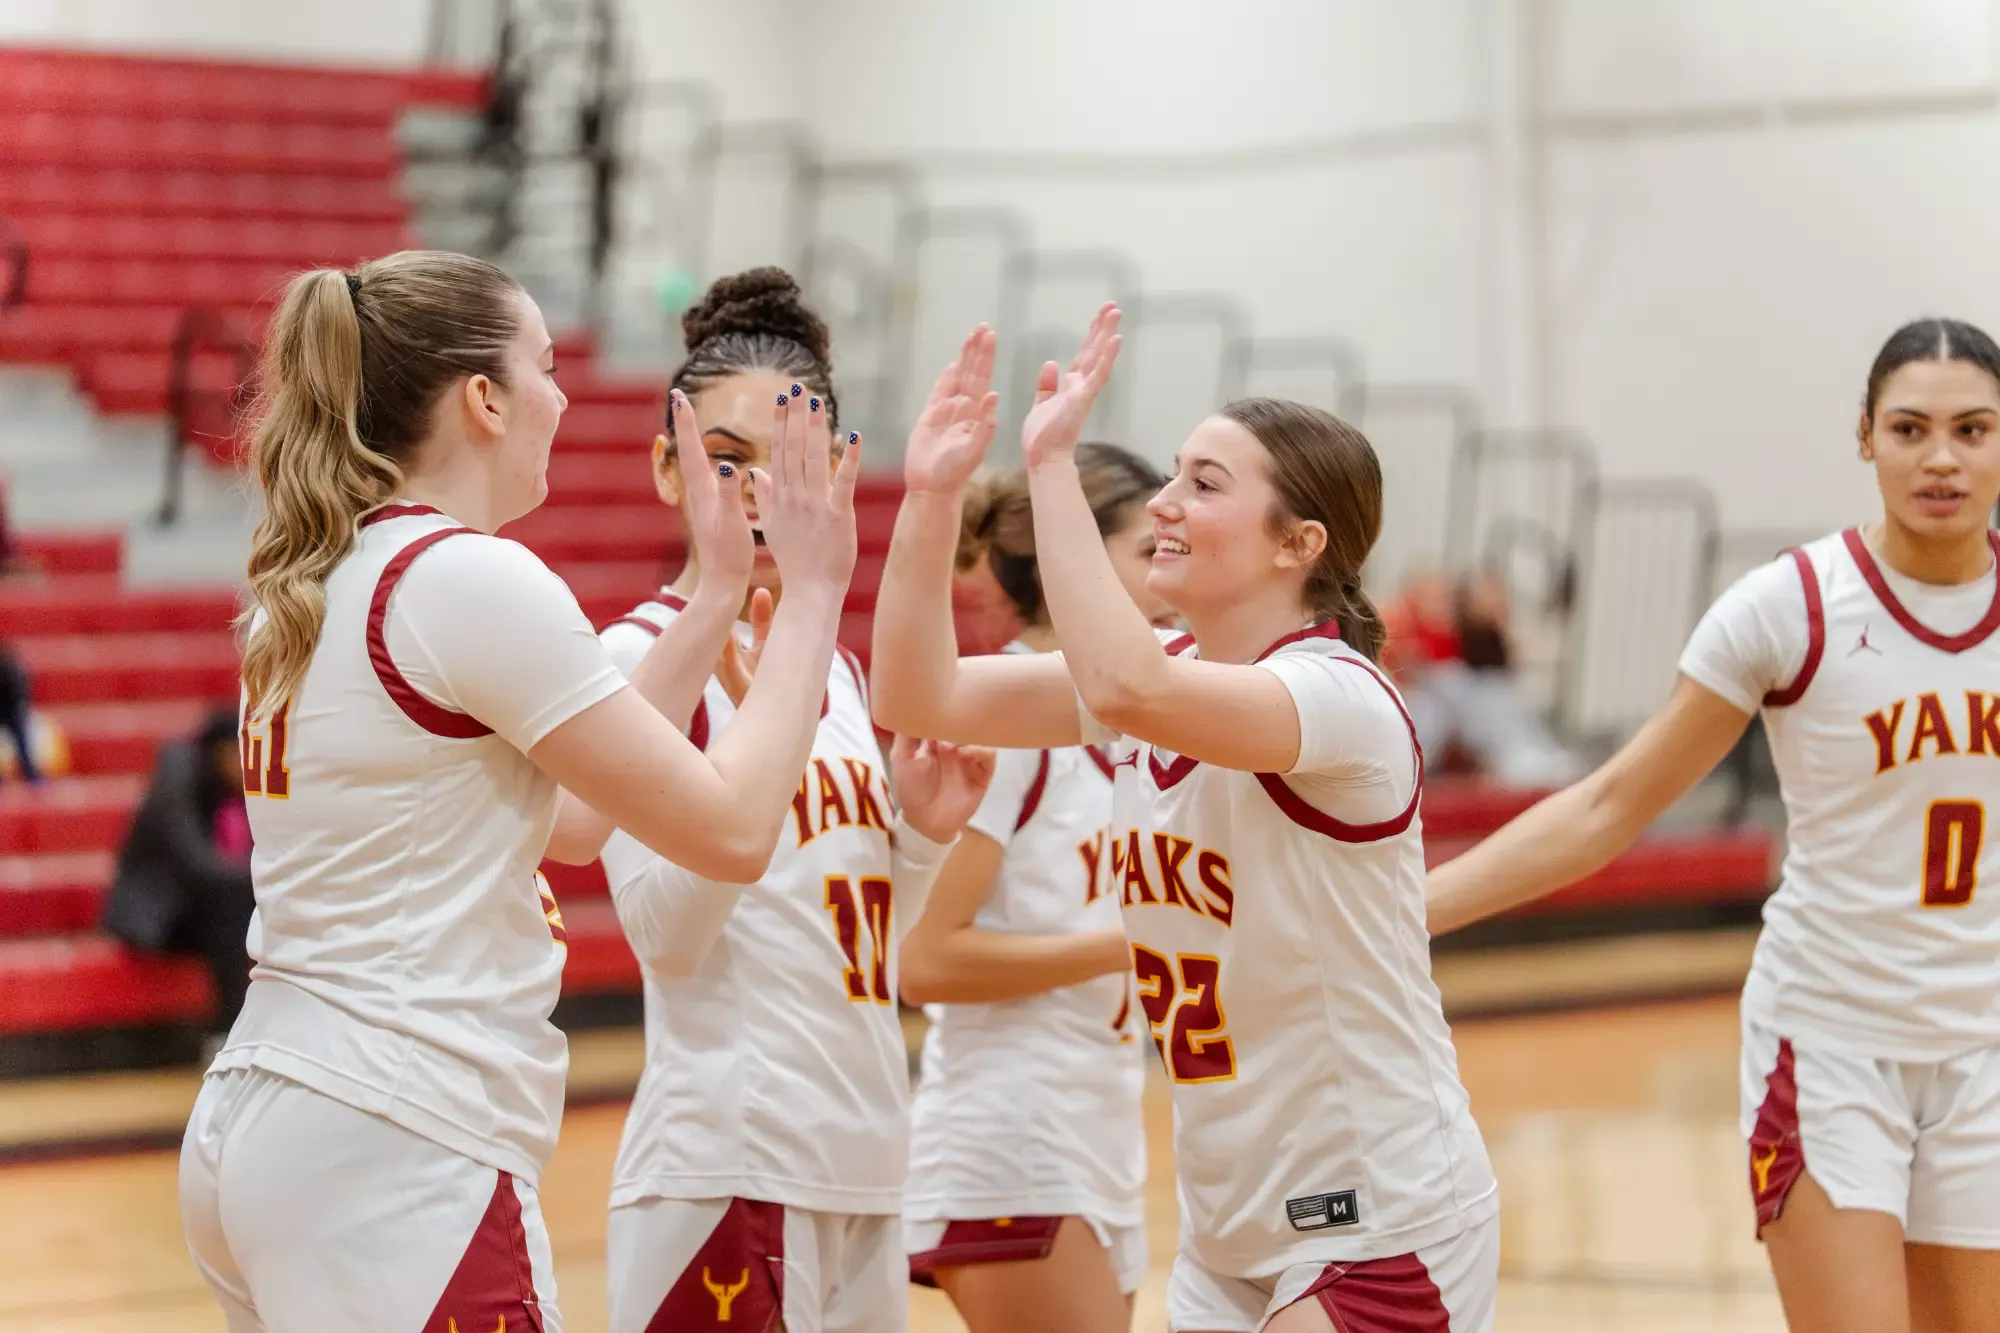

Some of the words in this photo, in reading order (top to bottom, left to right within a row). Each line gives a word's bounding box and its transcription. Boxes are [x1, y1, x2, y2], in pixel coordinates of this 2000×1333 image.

[792, 757, 895, 849] YAK
[1920, 797, 1985, 908] 0
[824, 874, 892, 1005] 10
[1131, 941, 1237, 1084] 22
[1332, 1201, 1347, 1217] M
